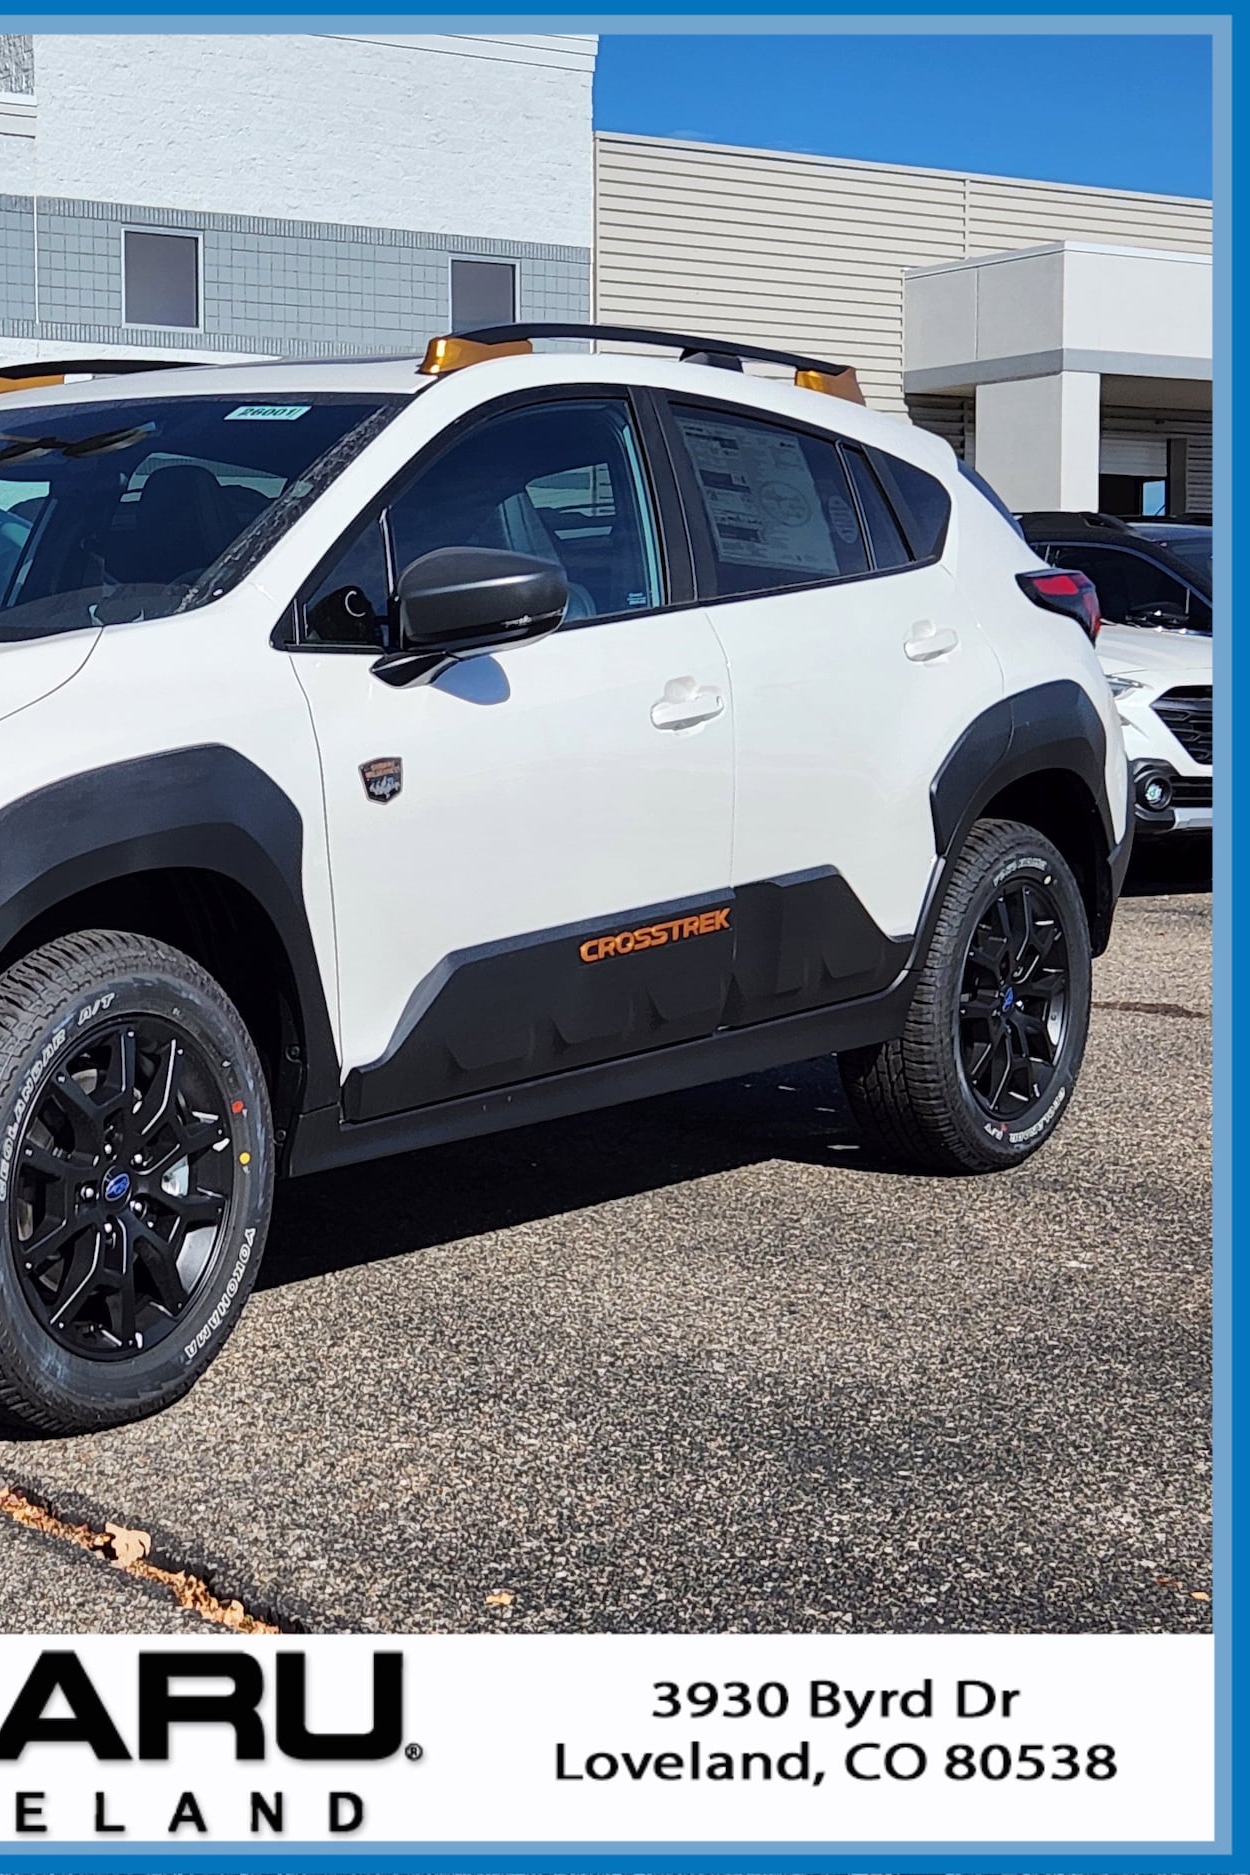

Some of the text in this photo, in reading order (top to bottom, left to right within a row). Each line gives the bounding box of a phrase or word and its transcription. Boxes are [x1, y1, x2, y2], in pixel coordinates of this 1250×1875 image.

[579, 907, 731, 963] CROSSTREK
[77, 992, 116, 1026] A/T
[183, 1227, 257, 1360] YOKOHAMA
